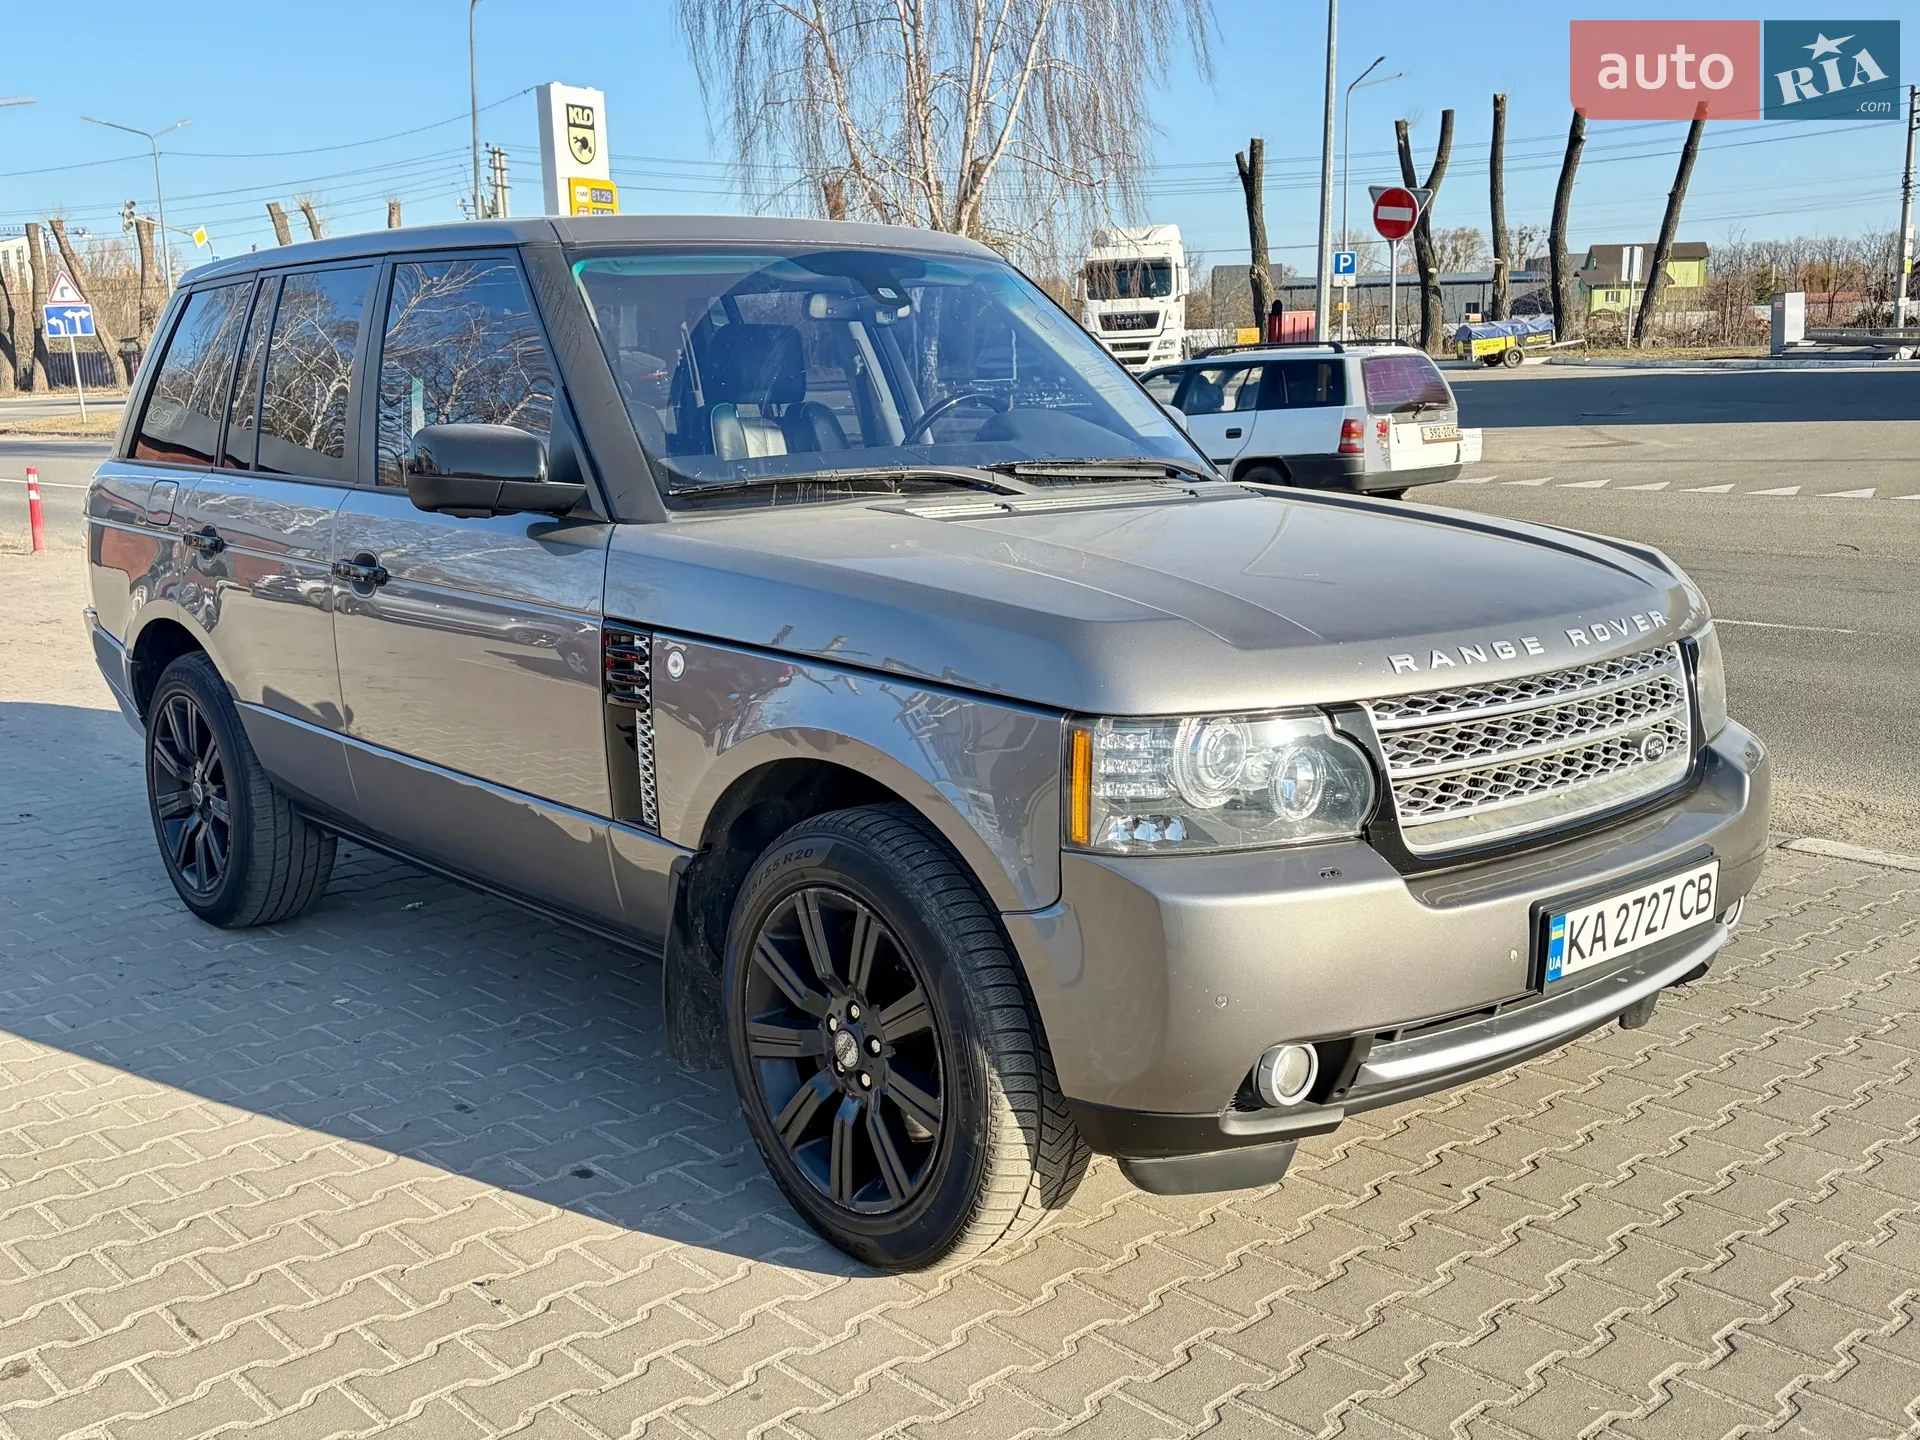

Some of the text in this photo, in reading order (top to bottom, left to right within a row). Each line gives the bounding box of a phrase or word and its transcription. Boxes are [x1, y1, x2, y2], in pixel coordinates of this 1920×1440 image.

[568, 106, 594, 126] KLO
[1339, 254, 1352, 273] P
[1387, 610, 1667, 674] RANGE ROVER
[783, 848, 815, 865] R20
[1567, 872, 1712, 964] KA 2727 CB
[1549, 957, 1561, 971] UA
